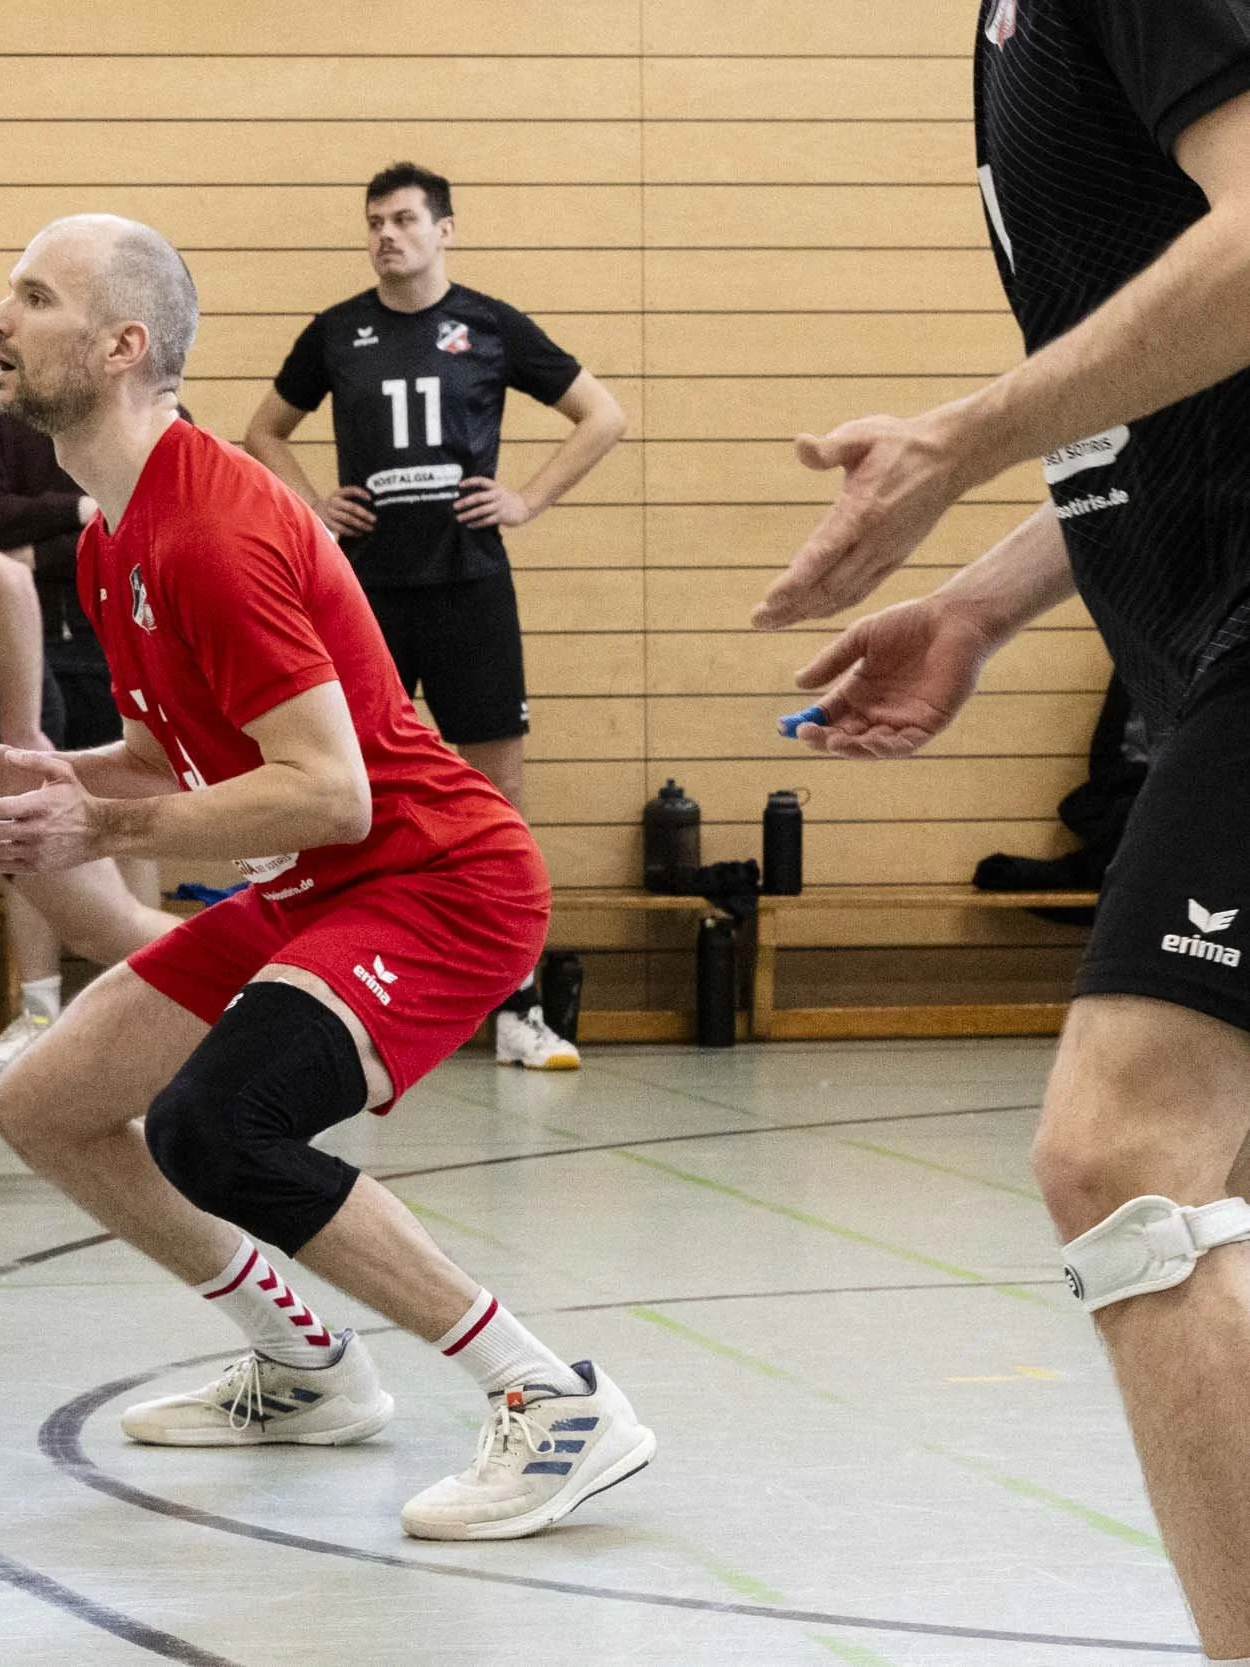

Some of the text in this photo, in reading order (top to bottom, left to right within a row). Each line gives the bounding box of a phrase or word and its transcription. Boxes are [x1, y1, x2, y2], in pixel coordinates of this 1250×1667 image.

[382, 376, 443, 449] 11
[1161, 933, 1242, 968] erima
[353, 963, 392, 1006] erima
